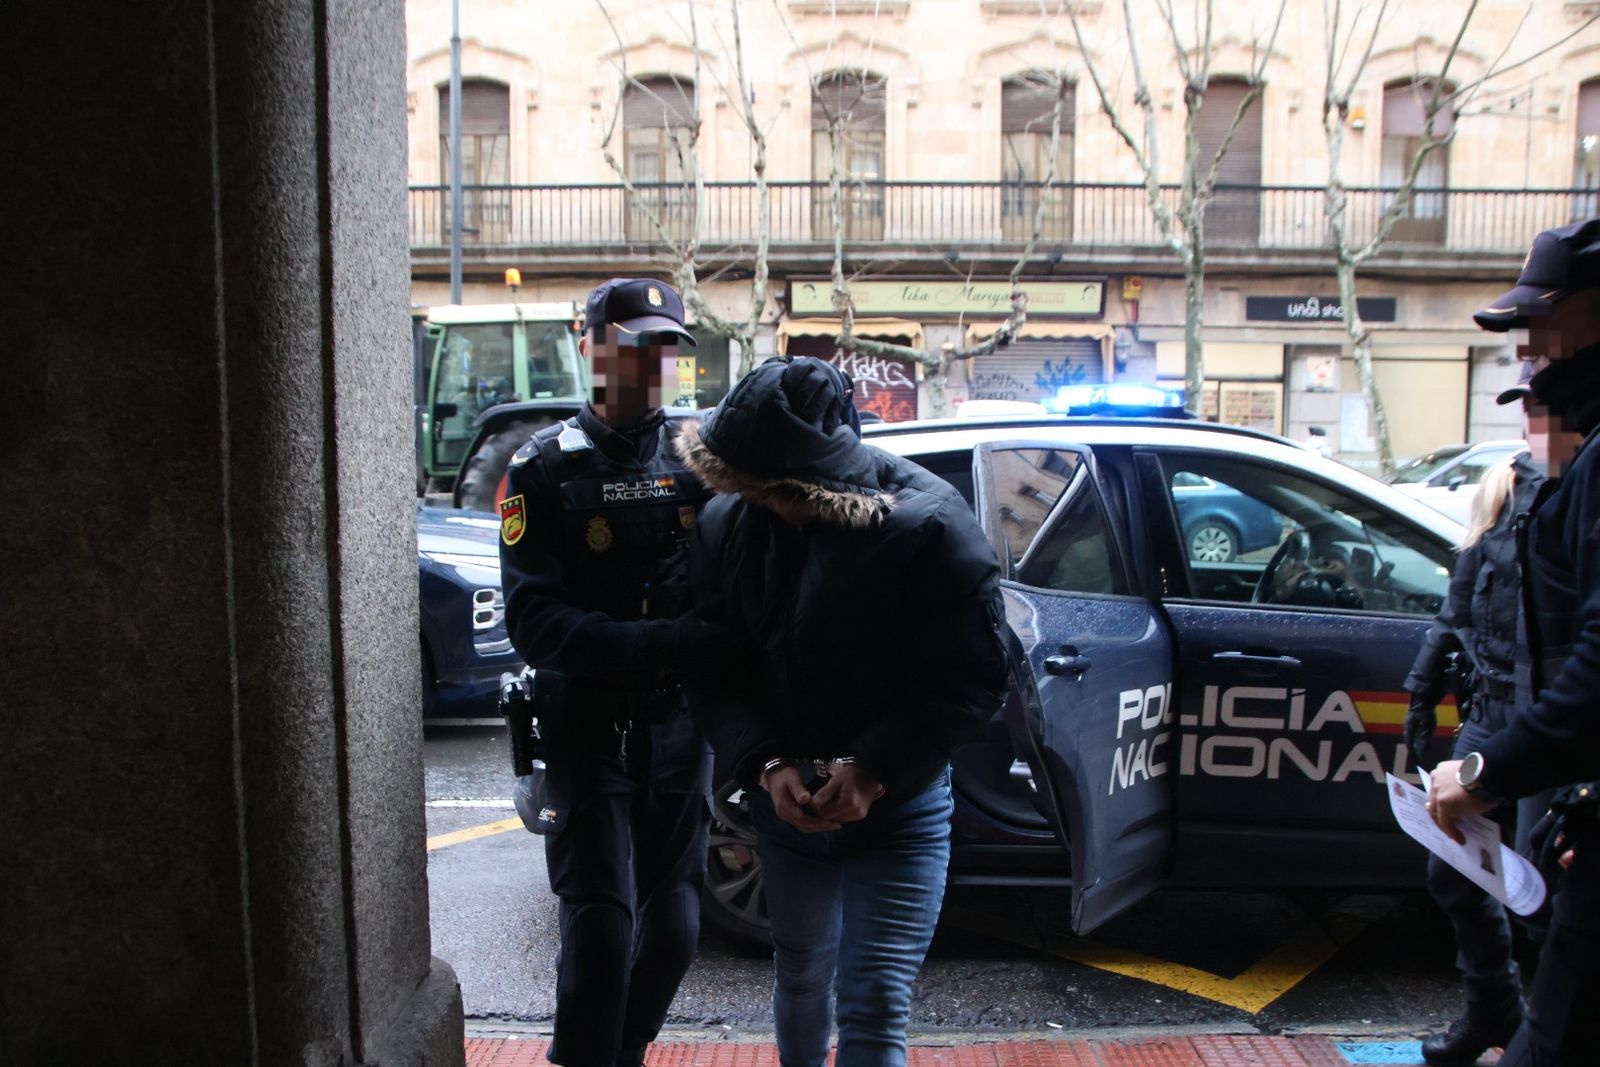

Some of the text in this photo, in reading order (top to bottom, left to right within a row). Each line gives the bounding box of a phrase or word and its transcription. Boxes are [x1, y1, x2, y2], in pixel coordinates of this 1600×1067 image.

[602, 479, 662, 493] POLICIA
[603, 487, 676, 502] NACIONAL
[1108, 732, 1424, 796] NACIONAL
